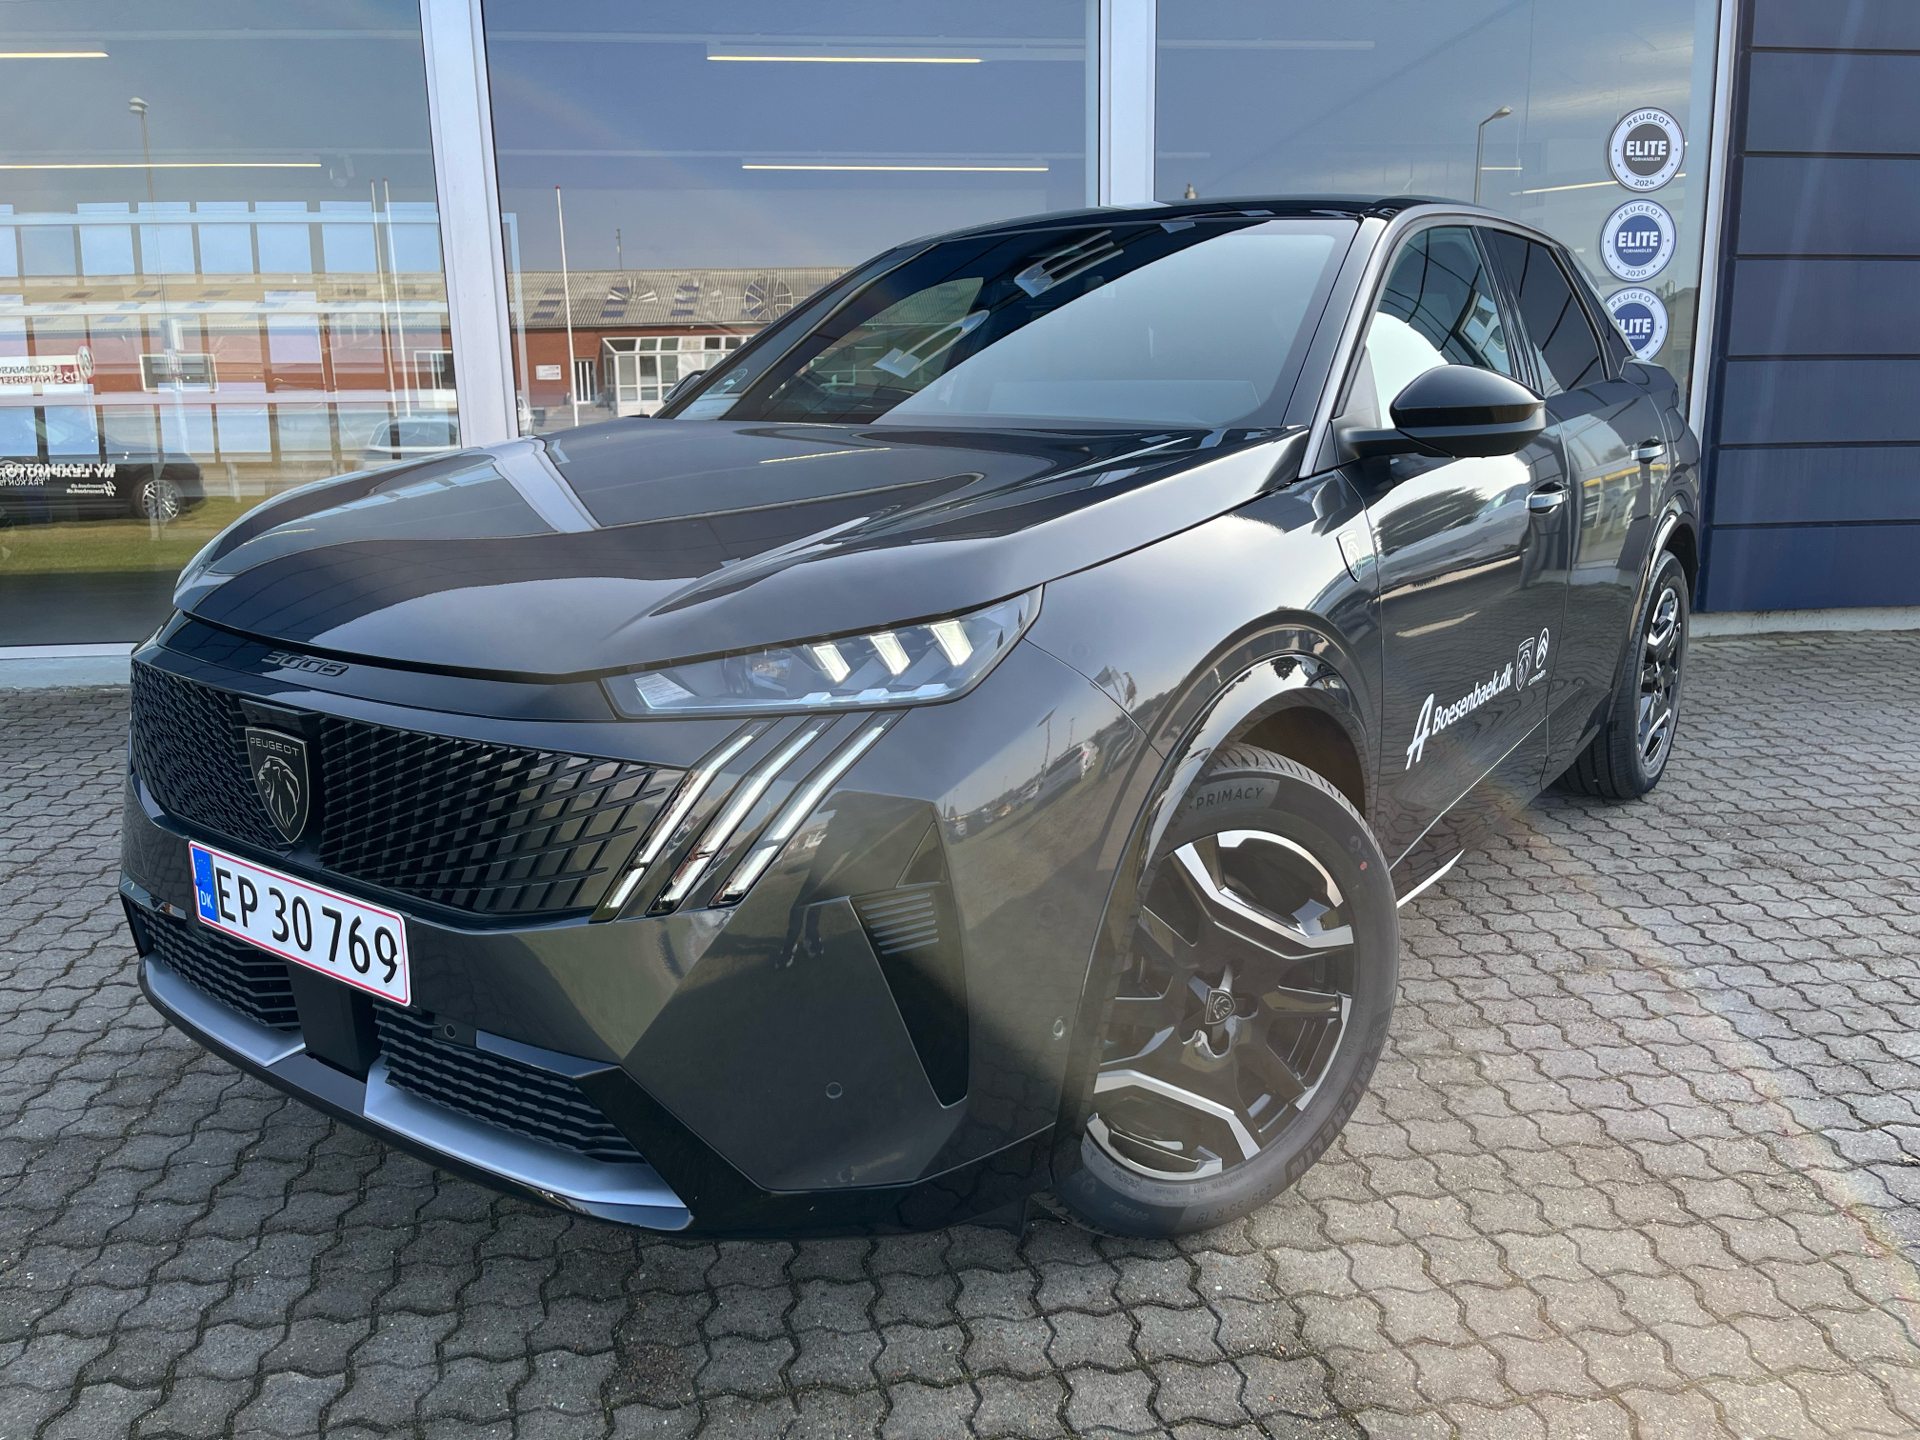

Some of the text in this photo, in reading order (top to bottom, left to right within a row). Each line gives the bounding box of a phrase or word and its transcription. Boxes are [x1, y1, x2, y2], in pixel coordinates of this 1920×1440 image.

[1626, 112, 1671, 128] PEUGEOT
[1626, 140, 1667, 156] ELITE
[1634, 179, 1655, 187] 2024
[1617, 204, 1664, 221] PEUGEOT
[1617, 231, 1659, 248] ELITE
[1625, 269, 1647, 277] 2020
[1610, 292, 1657, 308] PEUGEOT
[261, 650, 350, 677] 3008
[1432, 662, 1513, 735] Boesenbaek.dk
[250, 736, 300, 756] PEUGEOT
[1195, 787, 1265, 810] PRIMACY
[200, 890, 213, 909] DK
[215, 866, 398, 984] EP 30 769
[1290, 1055, 1373, 1180] MICHELIN
[1229, 1183, 1272, 1214] 235/55
[1108, 1200, 1150, 1221] OUTSIDE
[1196, 1211, 1210, 1225] 19
